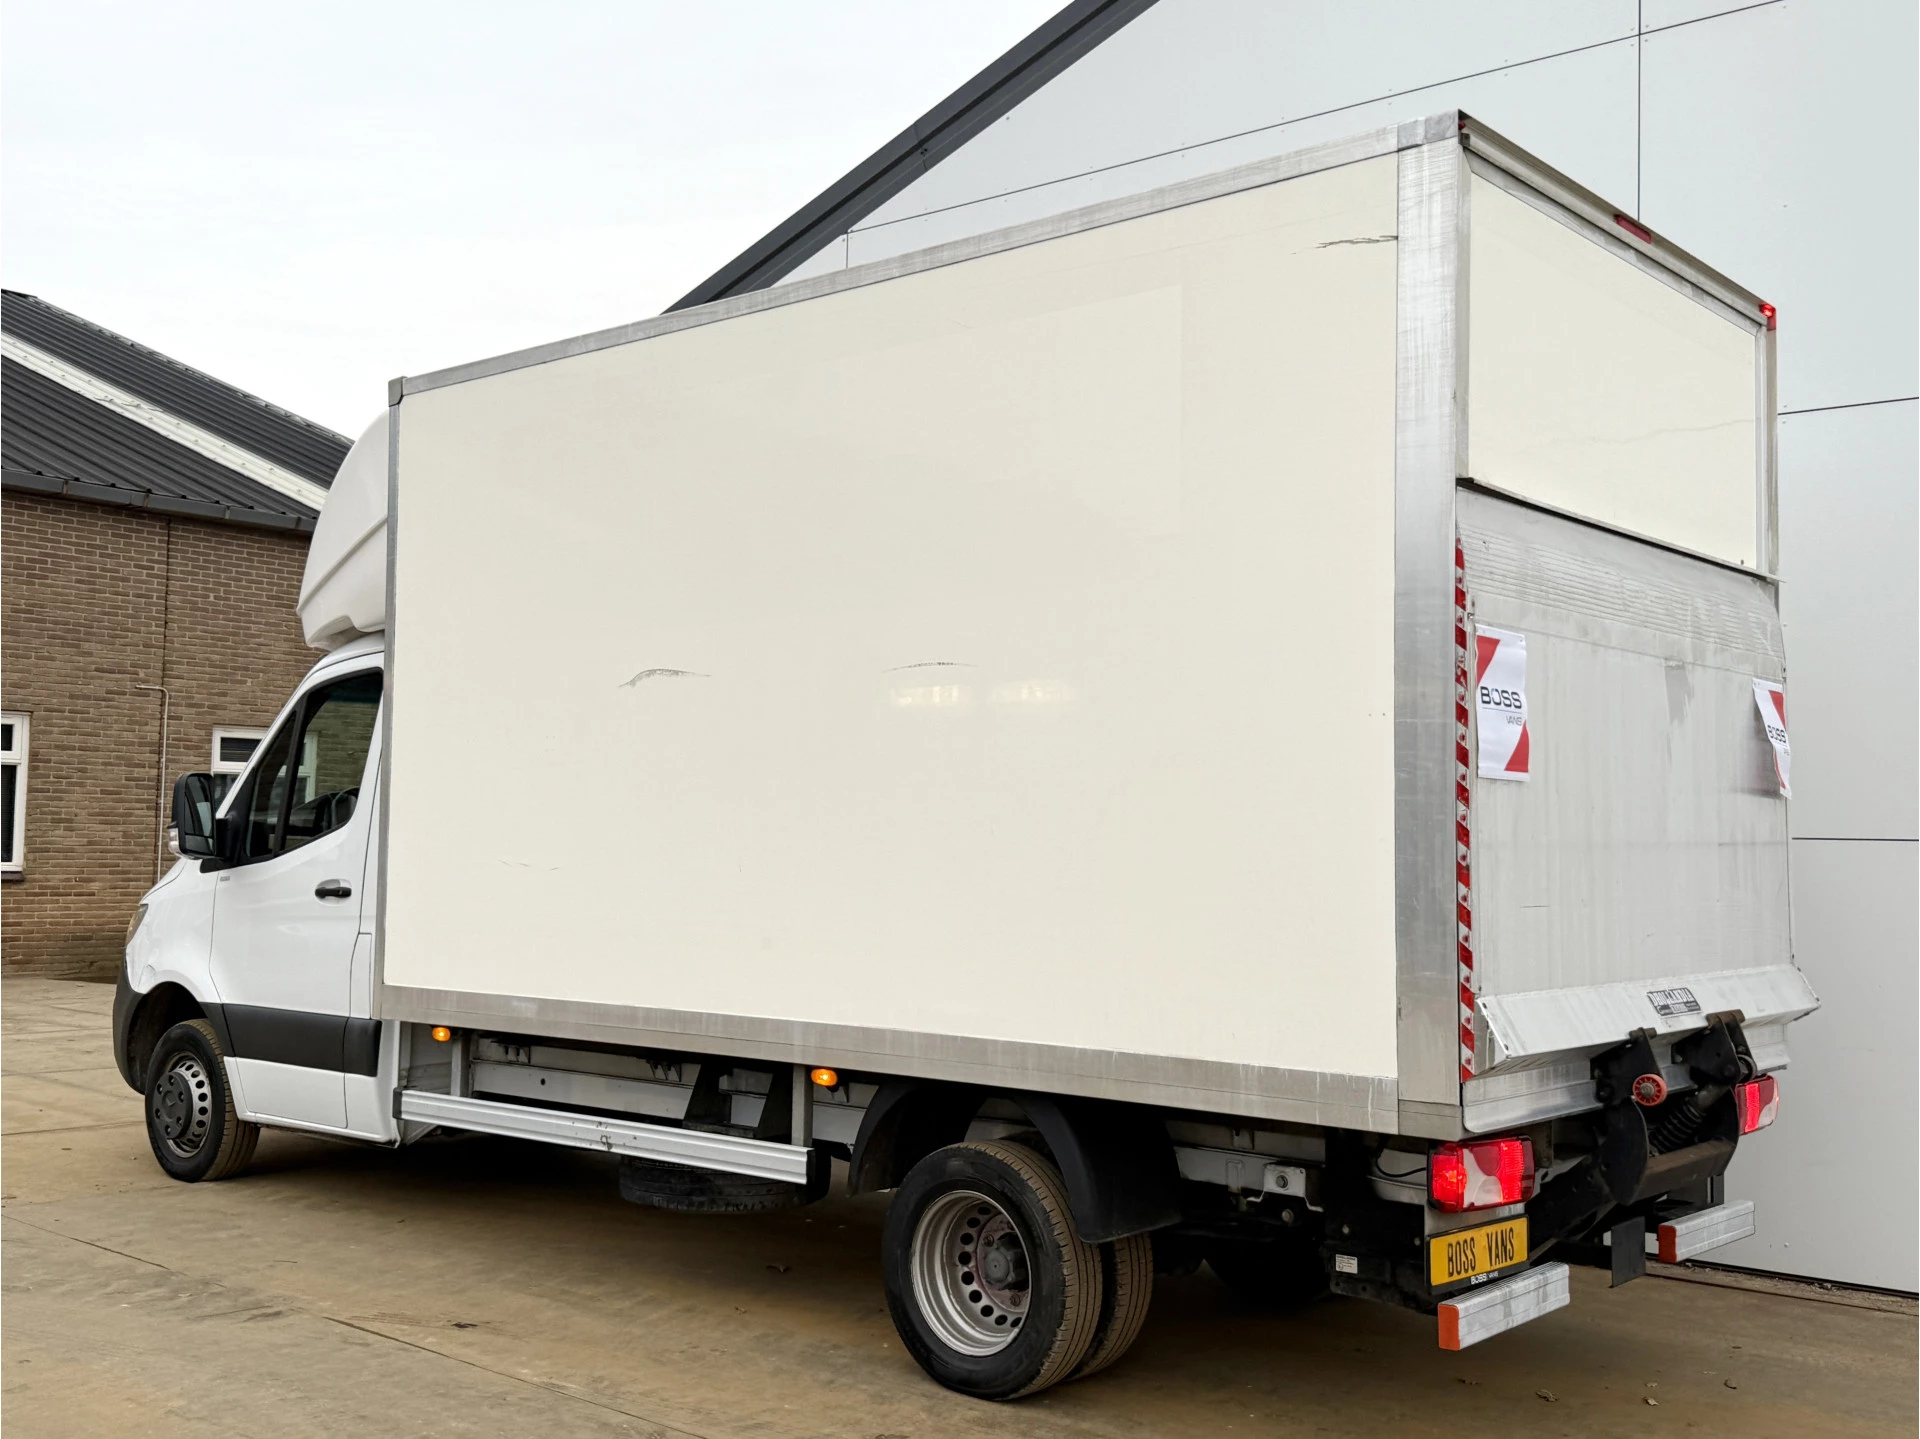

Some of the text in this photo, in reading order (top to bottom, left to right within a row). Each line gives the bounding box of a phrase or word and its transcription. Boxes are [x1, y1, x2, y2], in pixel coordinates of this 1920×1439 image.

[1480, 686, 1522, 709] BOSS
[1767, 725, 1787, 743] BOSS
[1447, 1227, 1514, 1278] BOSS VANS
[1470, 1273, 1487, 1285] BOSS
